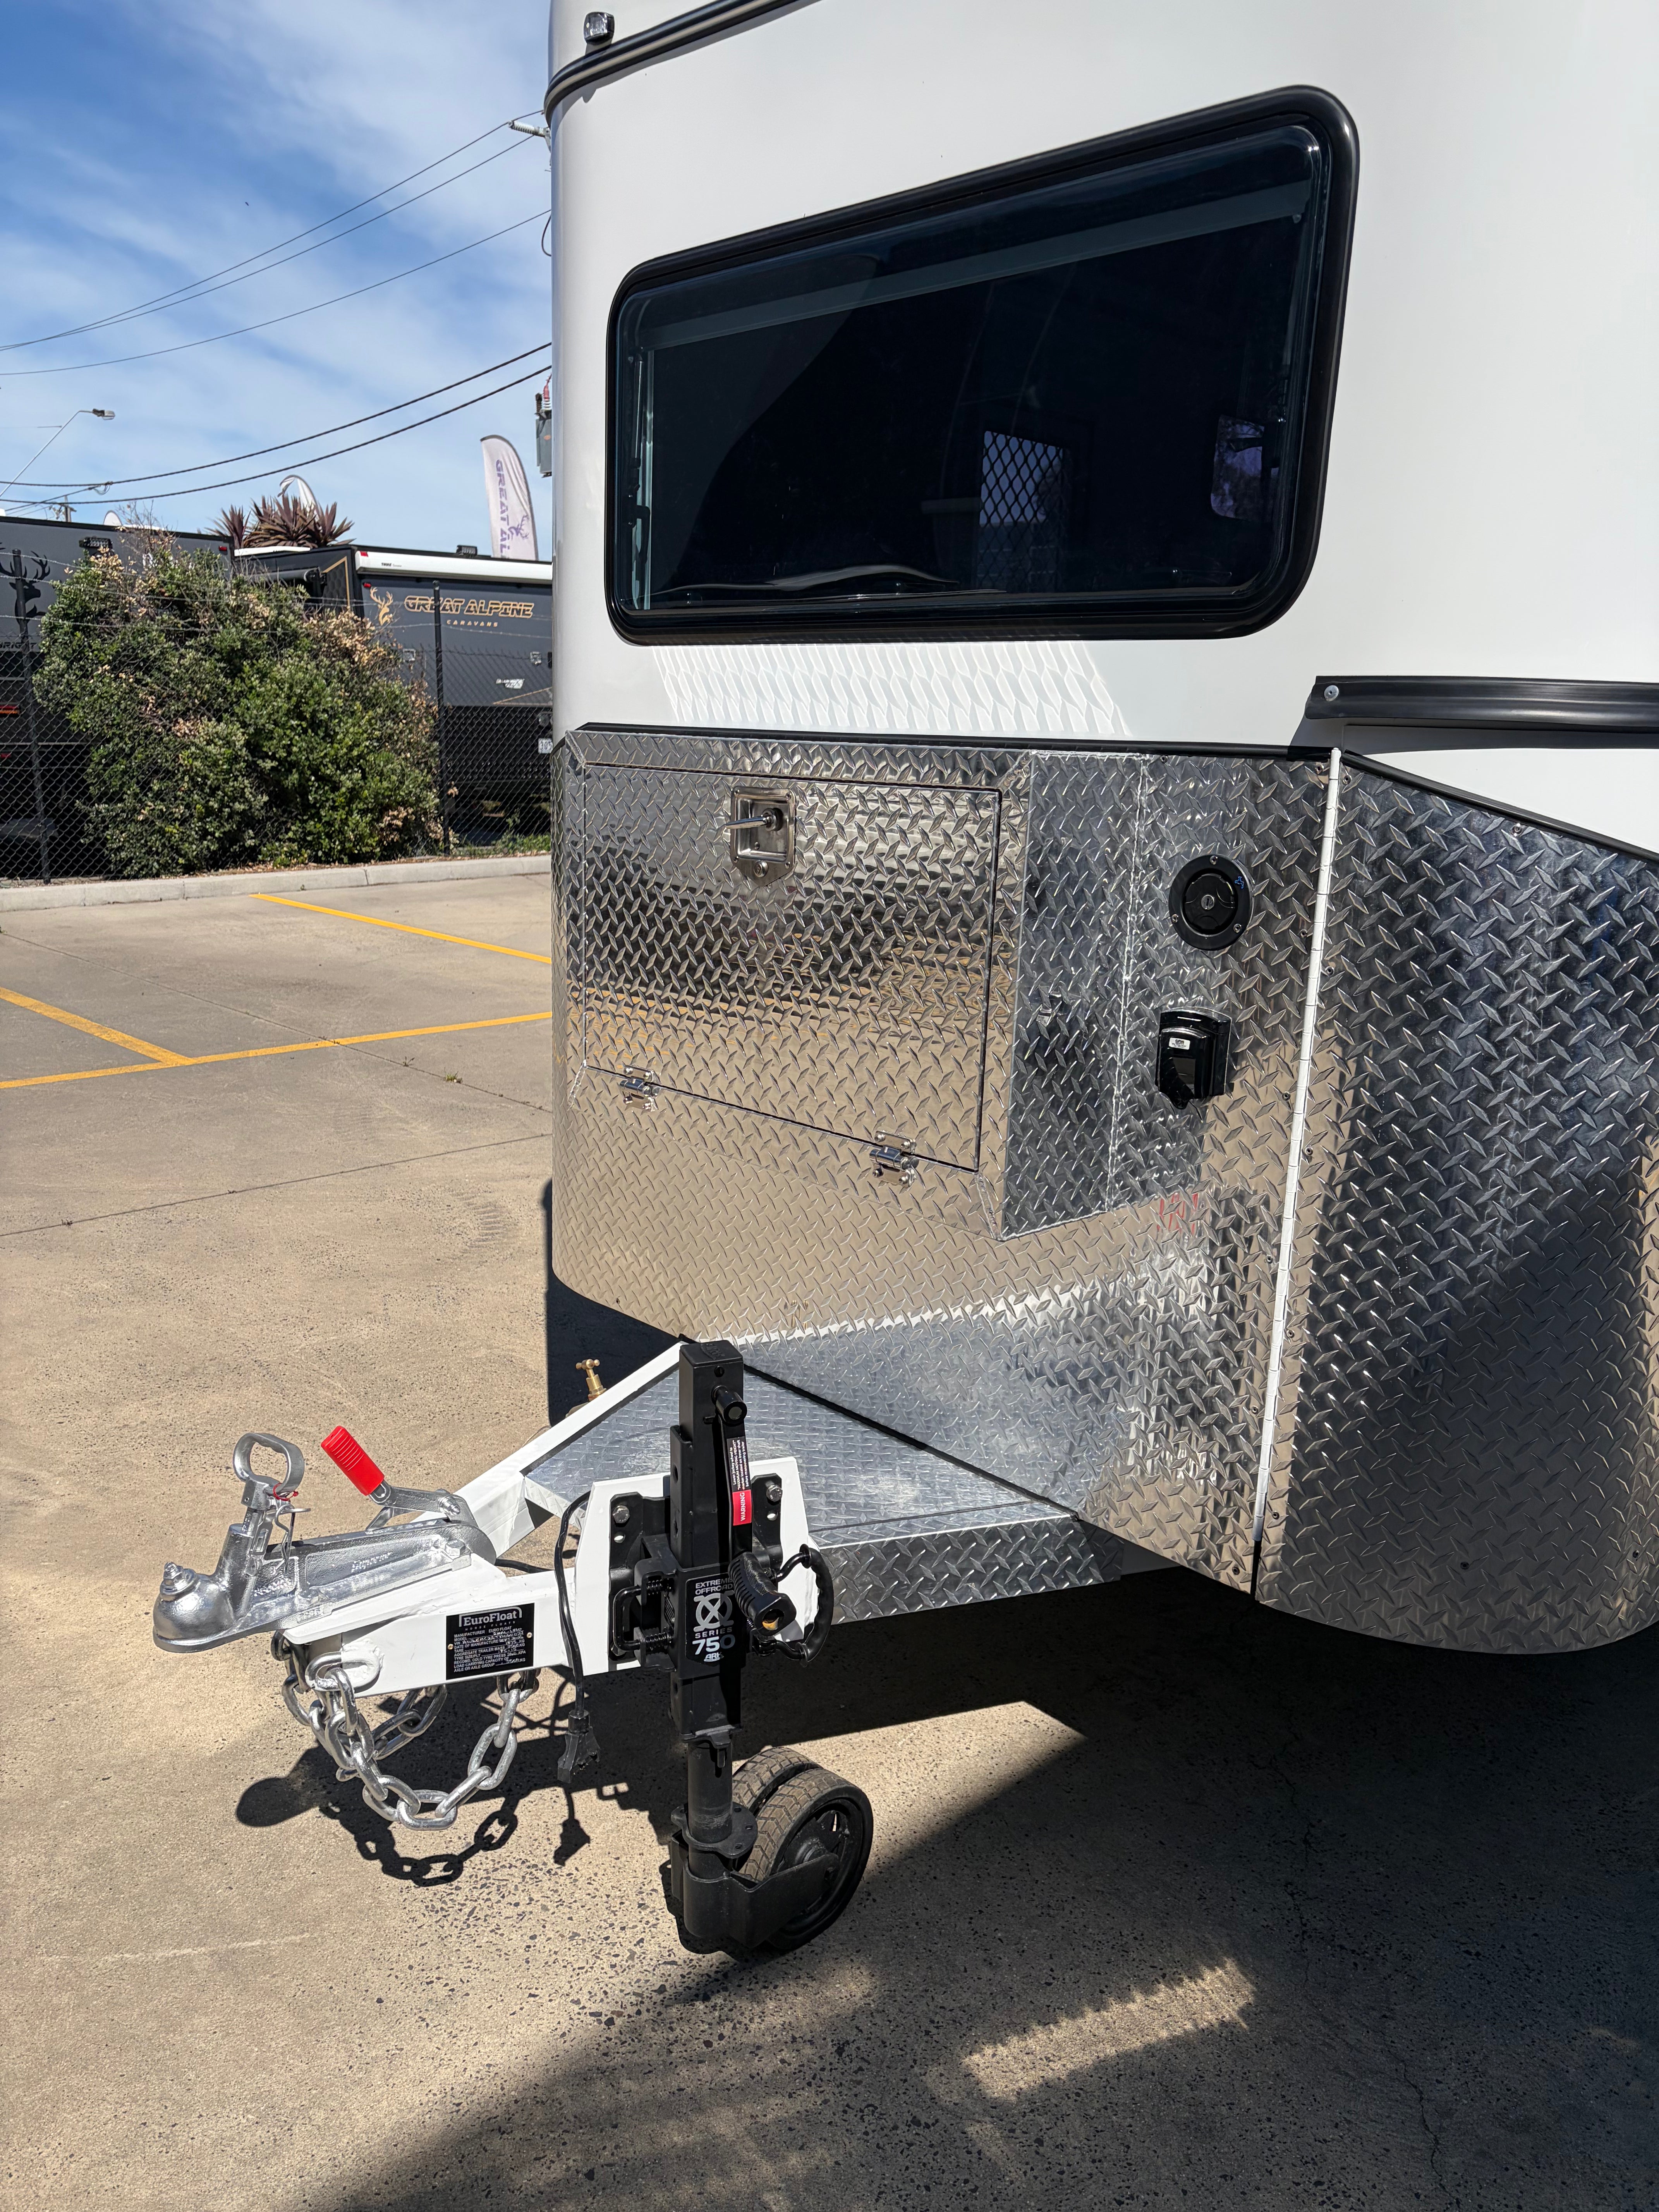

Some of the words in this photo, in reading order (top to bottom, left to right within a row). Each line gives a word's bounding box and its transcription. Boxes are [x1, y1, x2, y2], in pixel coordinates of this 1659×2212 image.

[496, 459, 510, 526] GREAT
[500, 528, 510, 558] AL
[404, 595, 465, 614] GREAT
[464, 599, 534, 619] ALPINE
[695, 1577, 733, 1589] EXTREME
[695, 1583, 733, 1595] OFFROAD
[464, 1611, 517, 1626] EuroFloat
[454, 1630, 485, 1638] MANUFACTURER
[695, 1627, 733, 1639] SERIES
[471, 1639, 498, 1647] MANUFACTURE
[692, 1634, 736, 1655] 750
[705, 1652, 722, 1660] ARK
